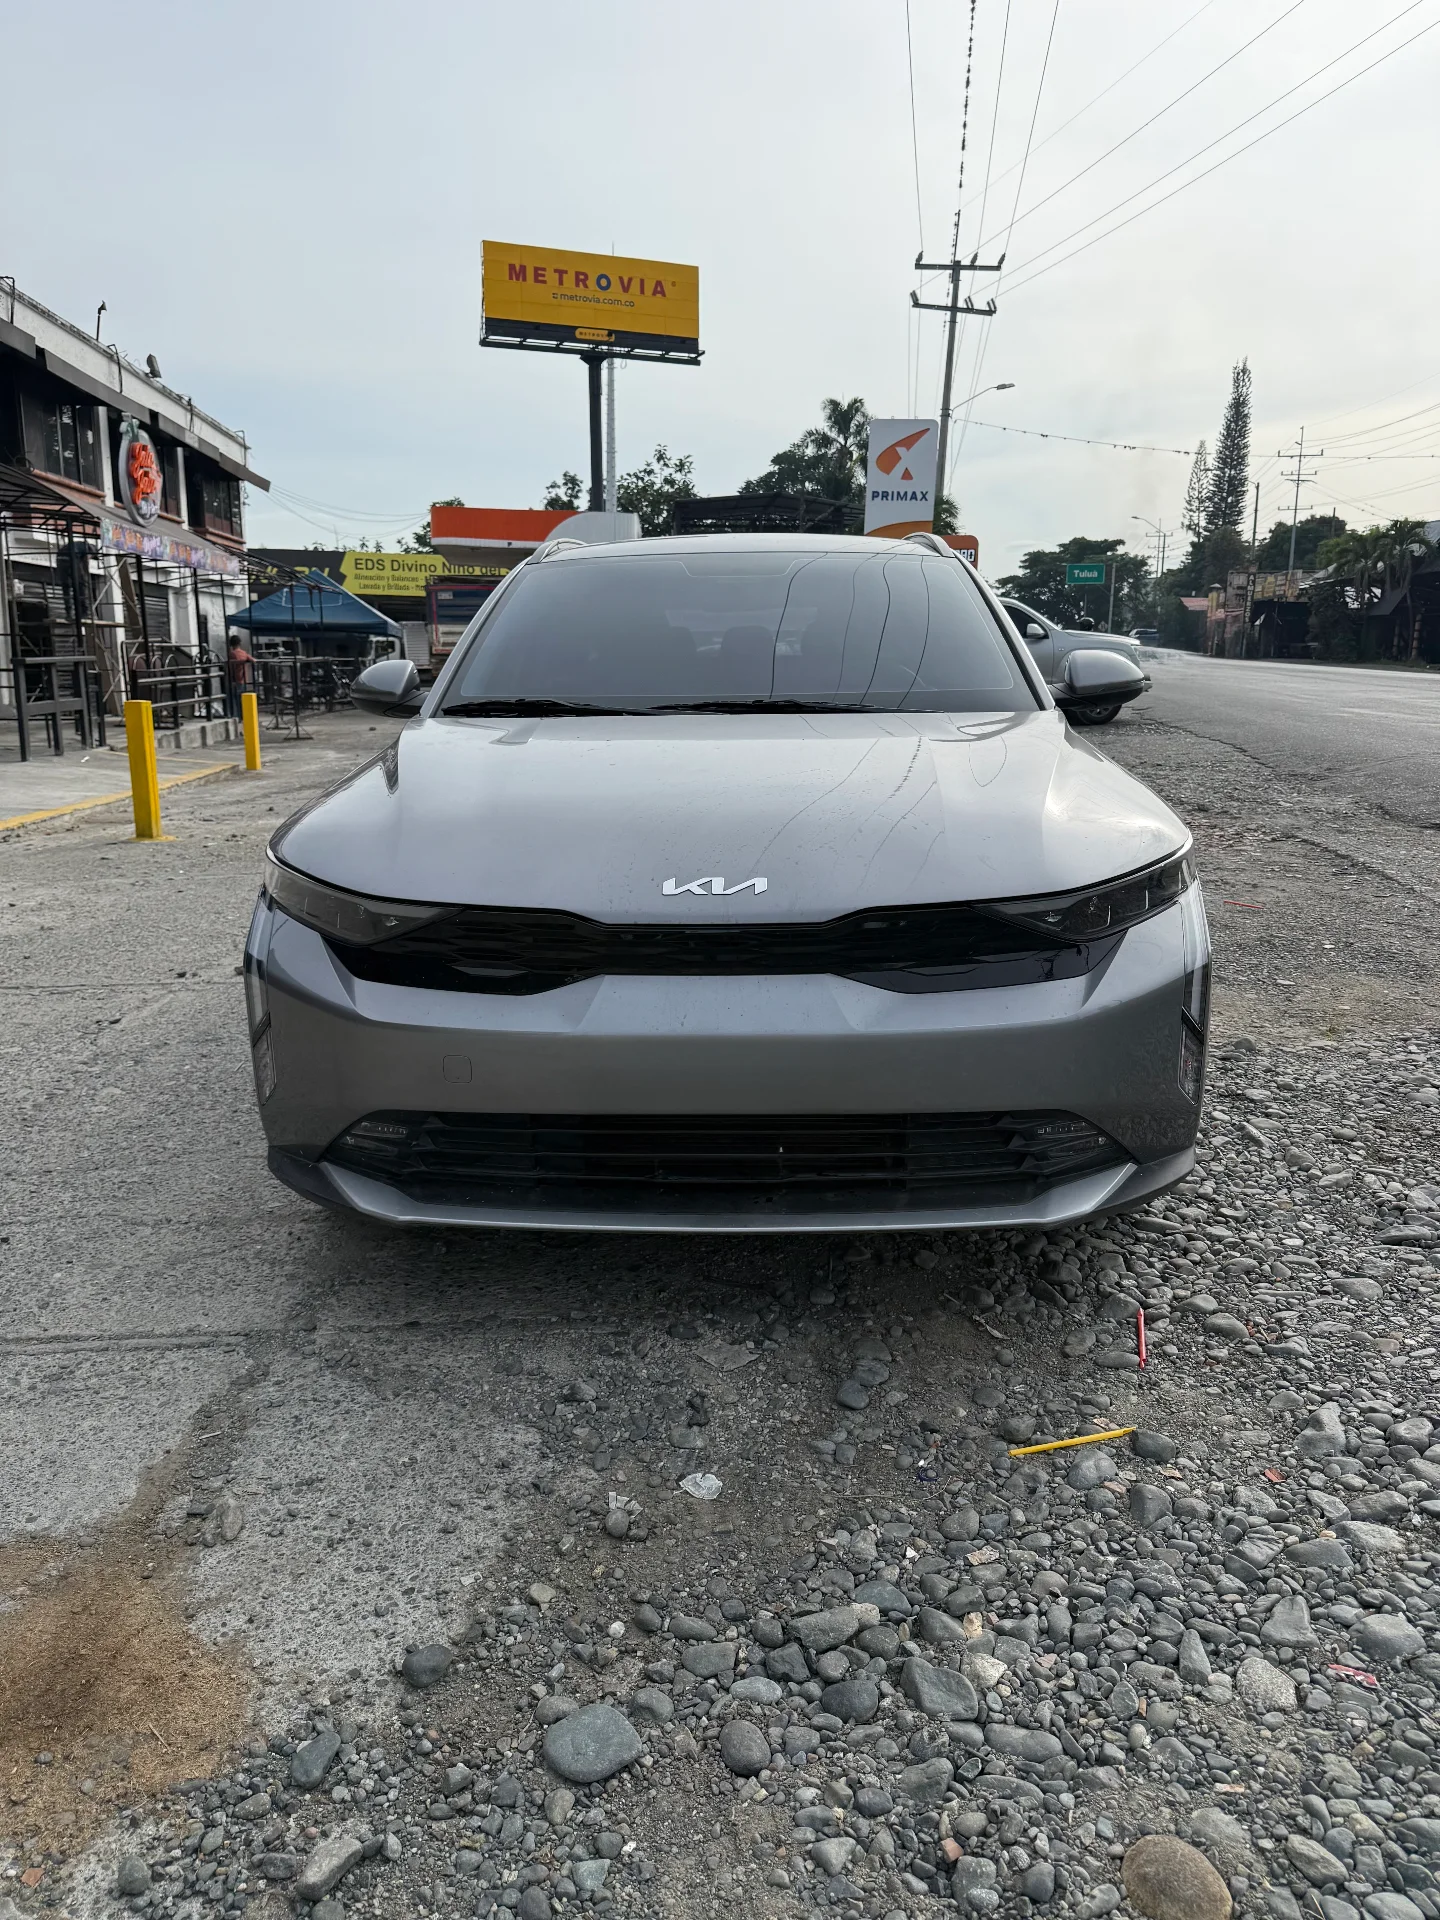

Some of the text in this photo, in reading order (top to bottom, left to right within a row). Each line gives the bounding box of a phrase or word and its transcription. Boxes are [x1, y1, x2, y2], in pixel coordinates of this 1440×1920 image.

[508, 263, 667, 298] METROVIA
[560, 292, 636, 308] metrovia.com.co
[871, 490, 929, 502] PRIMAX
[354, 558, 386, 571] EDS
[391, 559, 437, 573] Divino
